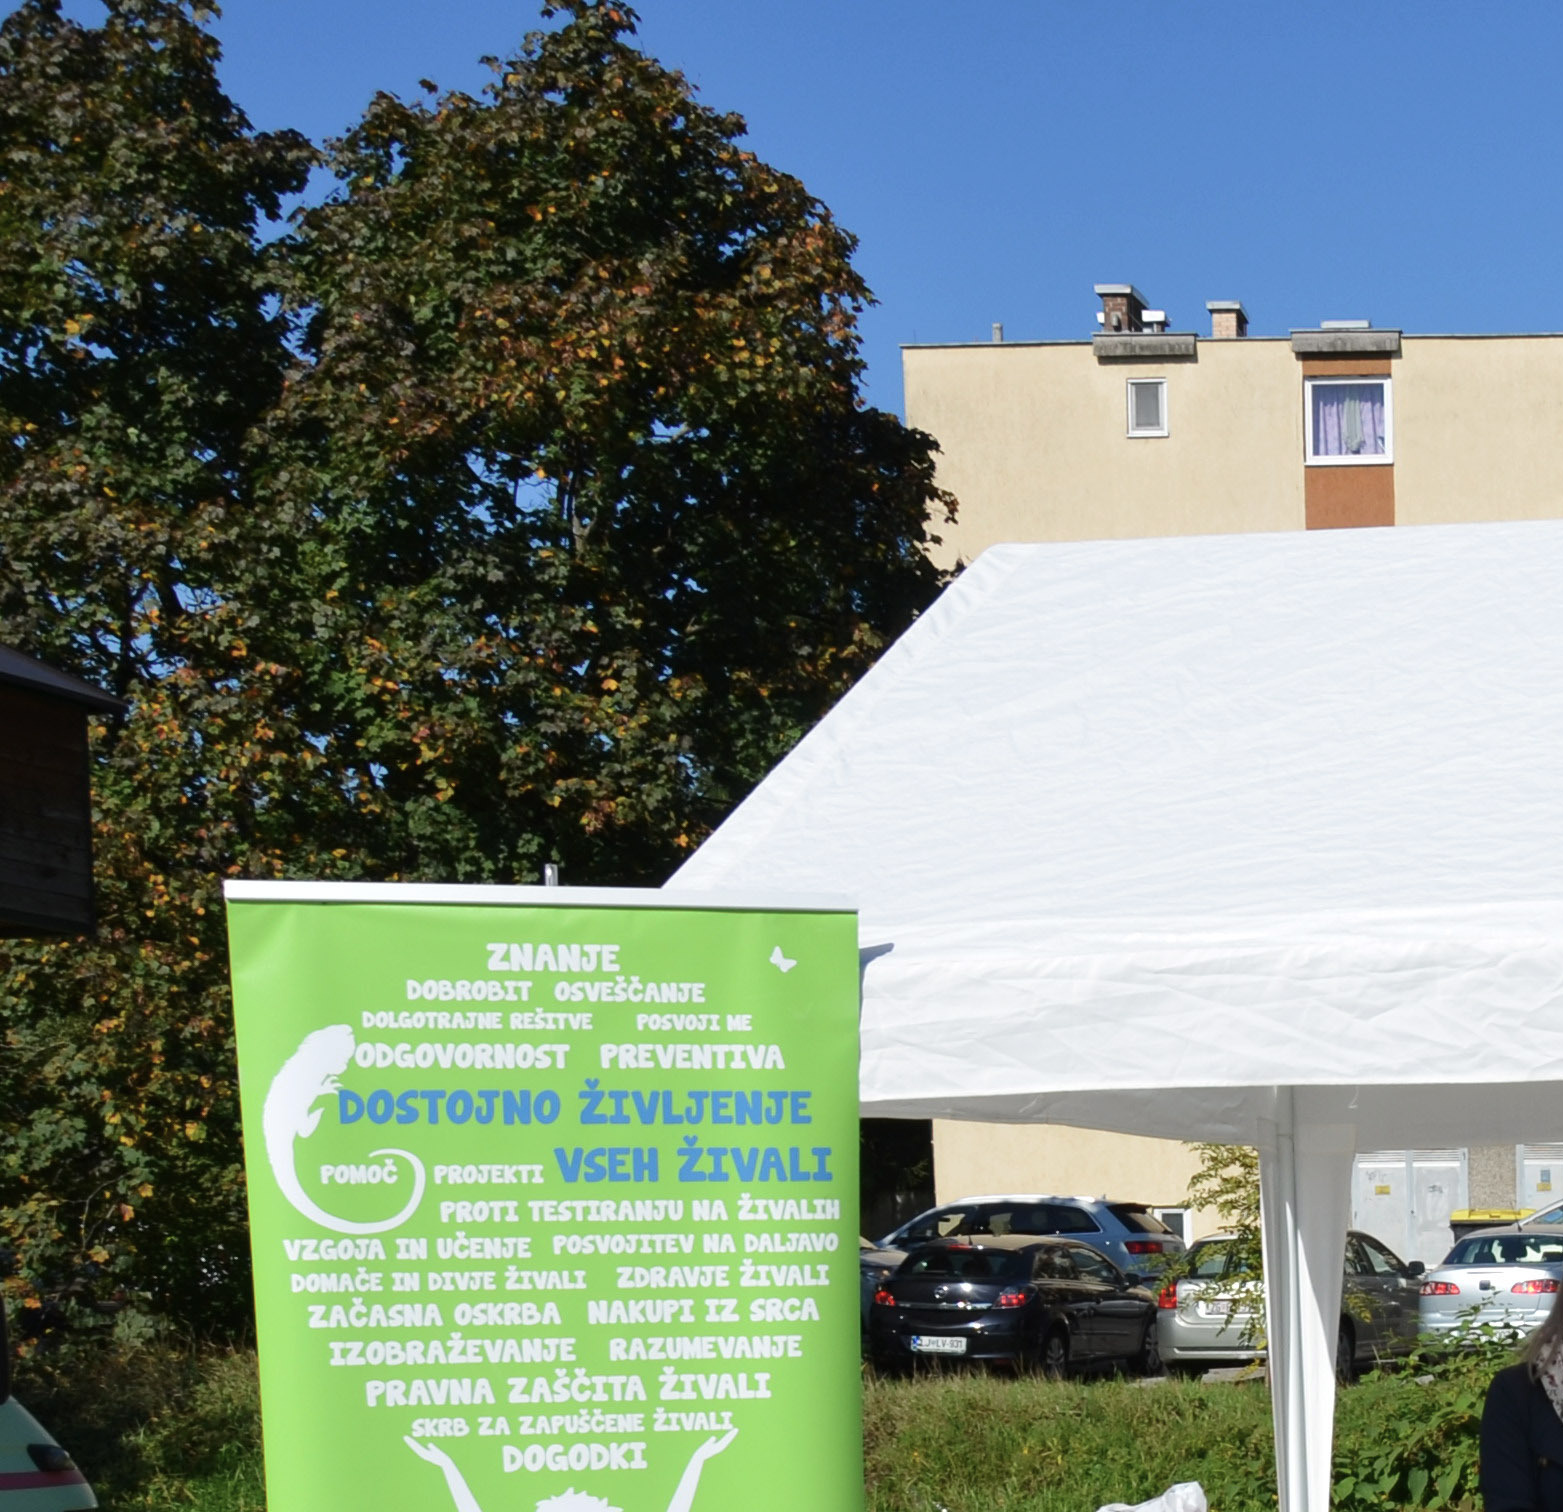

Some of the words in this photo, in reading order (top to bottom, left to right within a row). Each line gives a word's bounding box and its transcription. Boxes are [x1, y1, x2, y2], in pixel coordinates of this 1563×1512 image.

[486, 943, 620, 972] ZNANJE
[406, 980, 532, 1001] DOBROBIT
[554, 976, 705, 1003] OSVEŠČANJE
[362, 1011, 503, 1029] DOLGOTRAJNE
[510, 1007, 592, 1030] REŠITVE
[637, 1014, 720, 1031] POSVOJI
[726, 1014, 752, 1031] ME
[353, 1041, 570, 1069] ODGOVORNOST
[600, 1044, 785, 1069] PREVENTIVA
[339, 1090, 560, 1124] DOSTOJNO
[580, 1079, 811, 1124] ŽIVLJENJE
[320, 1156, 398, 1184] POMOČ
[555, 1148, 658, 1182] VSEH
[678, 1136, 832, 1181] ŽIVALI
[434, 1164, 544, 1184] PROJEKTI
[440, 1200, 519, 1223] PROTI
[528, 1200, 683, 1222] TESTIRANJU
[692, 1199, 728, 1221] NA
[737, 1192, 839, 1220] ŽIVALIH
[282, 1239, 386, 1261] VZGOJA
[396, 1238, 427, 1260] IN
[437, 1231, 532, 1259] UČENJE
[552, 1234, 695, 1254] POSVOJITEV
[703, 1233, 736, 1253] NA
[744, 1233, 838, 1253] DALJAVO
[290, 1267, 384, 1293] DOMAČE
[392, 1272, 420, 1291] IN
[428, 1271, 496, 1291] DIVJE
[504, 1265, 586, 1290] ŽIVALI
[616, 1265, 730, 1288] ZDRAVJE
[739, 1258, 829, 1287] ŽIVALI
[308, 1297, 443, 1328] ZAČASNA
[454, 1303, 562, 1326] OSKRBA
[588, 1299, 695, 1324] NAKUPI
[704, 1298, 740, 1322] IZ
[750, 1298, 819, 1322] SRCA
[329, 1332, 576, 1369] IZOBRAŽEVANJE
[609, 1335, 802, 1361] RAZUMEVANJE
[366, 1378, 496, 1407] PRAVNA
[507, 1368, 647, 1403] ZAŠČITA
[659, 1366, 771, 1400] ŽIVALI
[409, 1418, 470, 1440] SKRB
[478, 1416, 510, 1436] ZA
[518, 1410, 645, 1435] ZAPUŠČENE
[653, 1408, 735, 1434] ŽIVALI
[502, 1442, 647, 1472] DOGODKI
